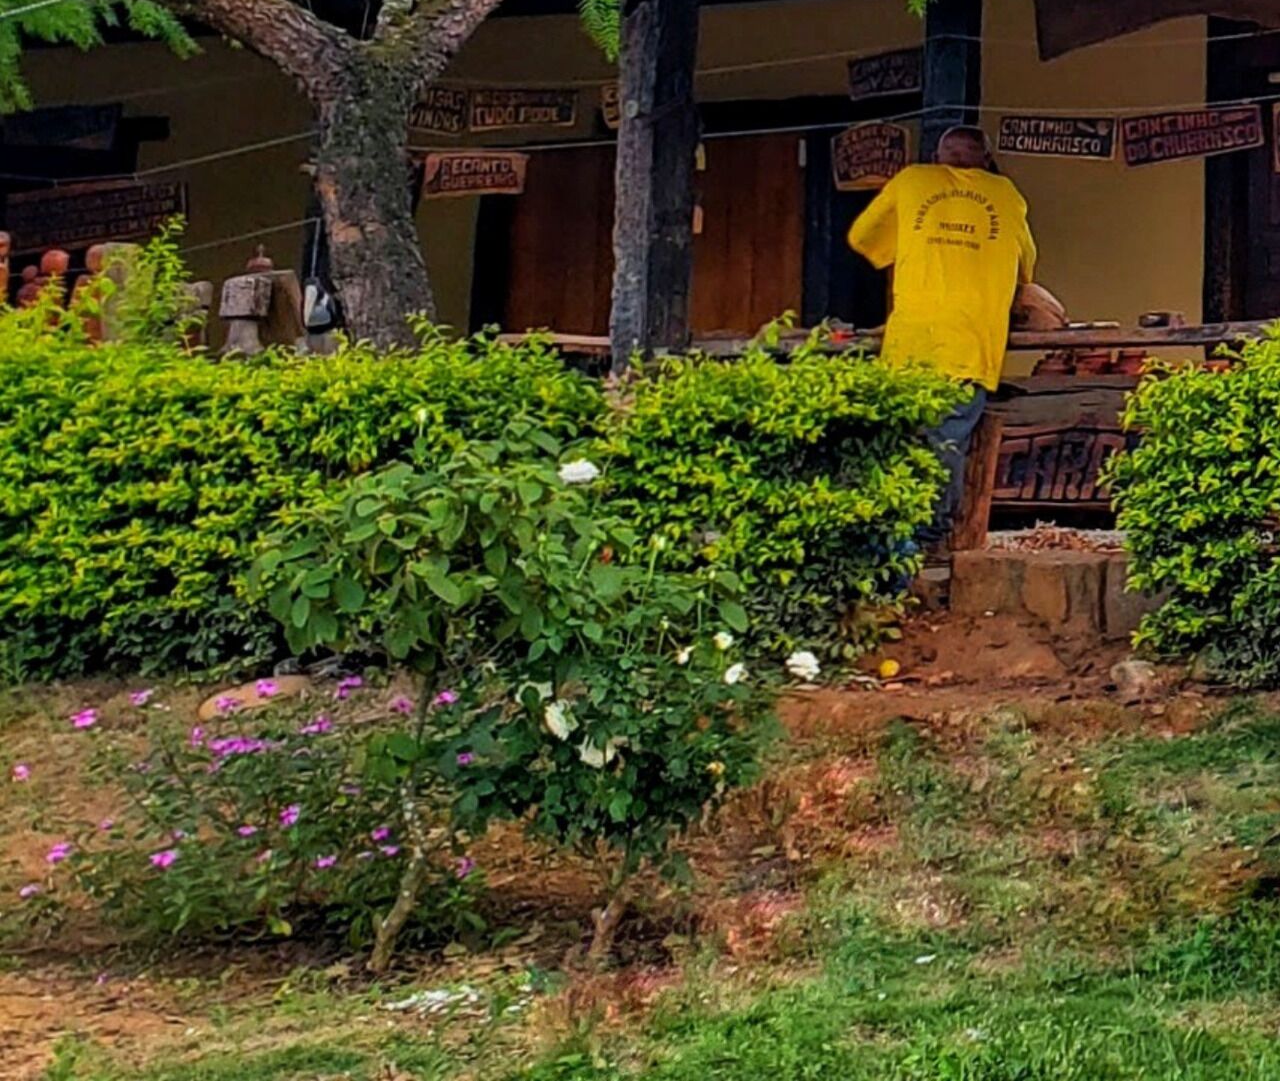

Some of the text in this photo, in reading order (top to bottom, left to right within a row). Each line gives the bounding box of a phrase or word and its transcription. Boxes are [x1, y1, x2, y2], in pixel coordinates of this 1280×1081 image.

[476, 106, 560, 125] TUDO PODE
[1001, 118, 1075, 135] CANTINHO
[1125, 112, 1220, 140] CANTINHO
[1001, 134, 1101, 154] DO CHURRASCO
[1127, 122, 1257, 163] DO CHURRASCO
[441, 159, 510, 175] RECANTO
